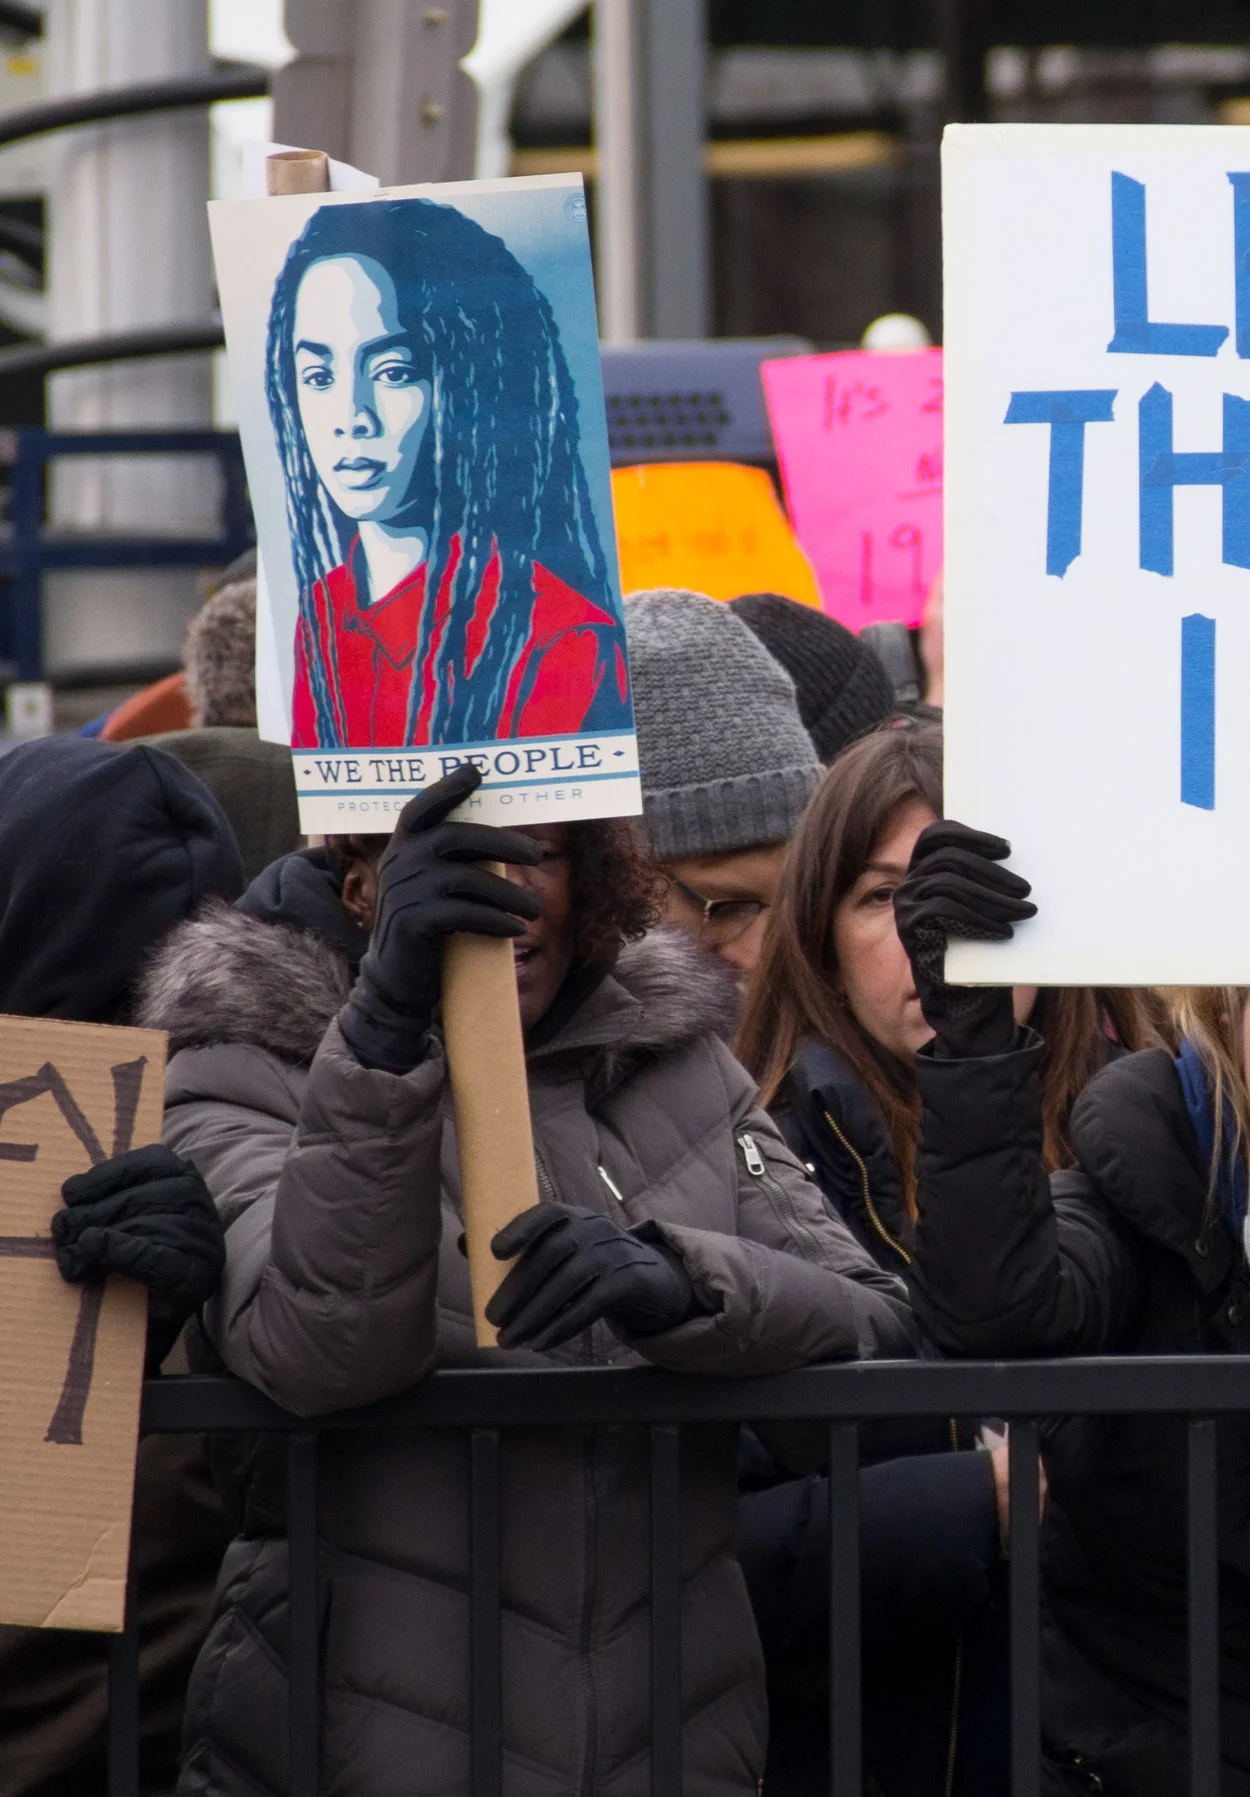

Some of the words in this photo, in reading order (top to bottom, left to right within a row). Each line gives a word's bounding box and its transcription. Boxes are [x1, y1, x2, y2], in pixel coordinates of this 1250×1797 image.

[314, 759, 363, 783] WE
[369, 758, 427, 782] THE
[438, 743, 603, 778] PEOPLE
[338, 800, 409, 812] PROTEC
[499, 788, 583, 805] OTHER
